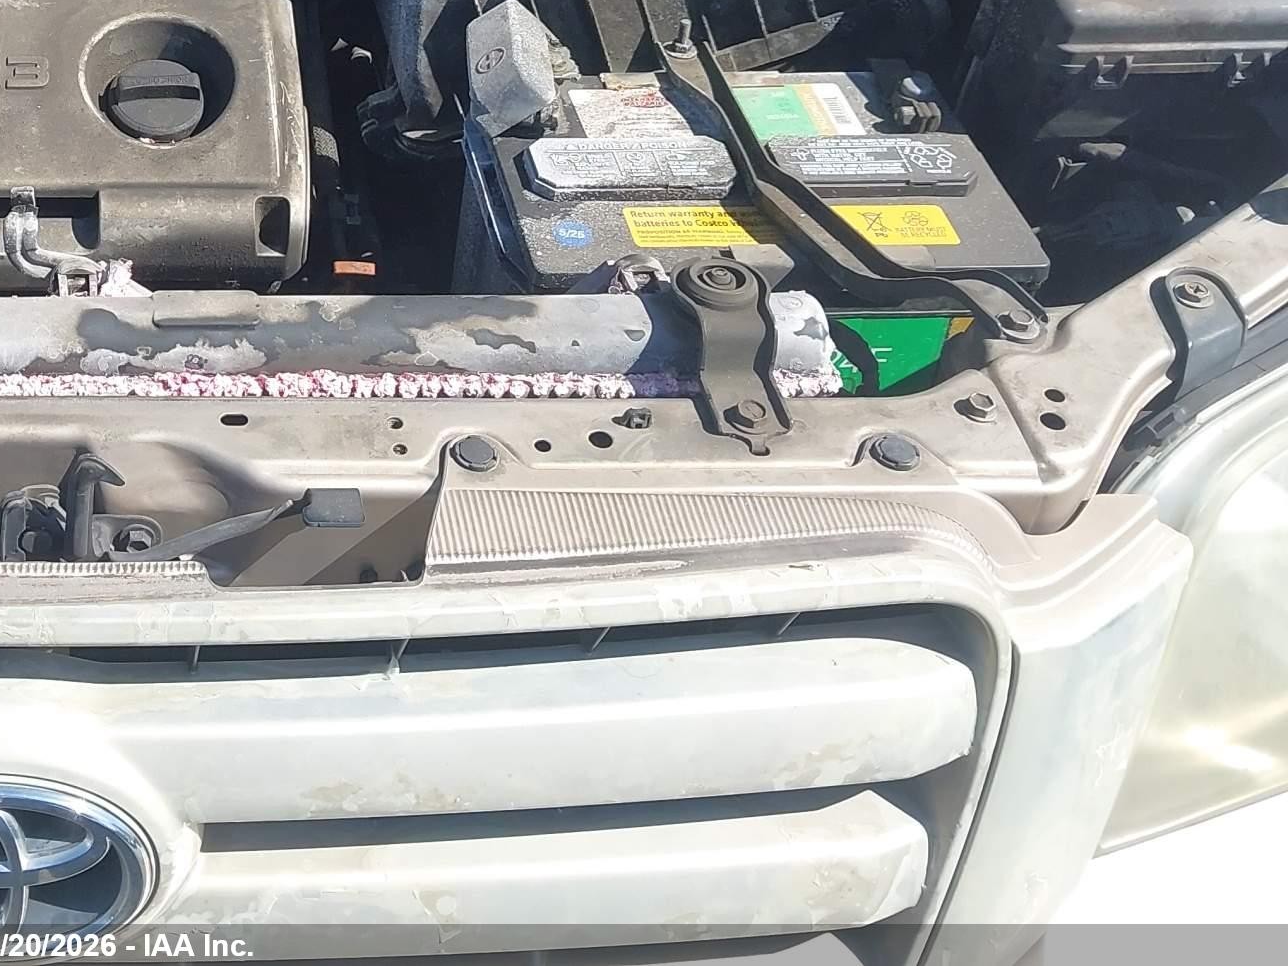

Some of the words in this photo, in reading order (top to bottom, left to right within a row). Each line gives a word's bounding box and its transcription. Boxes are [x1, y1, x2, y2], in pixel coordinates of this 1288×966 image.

[630, 210, 666, 218] Return
[668, 210, 716, 219] warranty
[634, 219, 681, 227] batteries
[682, 219, 694, 227] to
[694, 219, 729, 227] Costco
